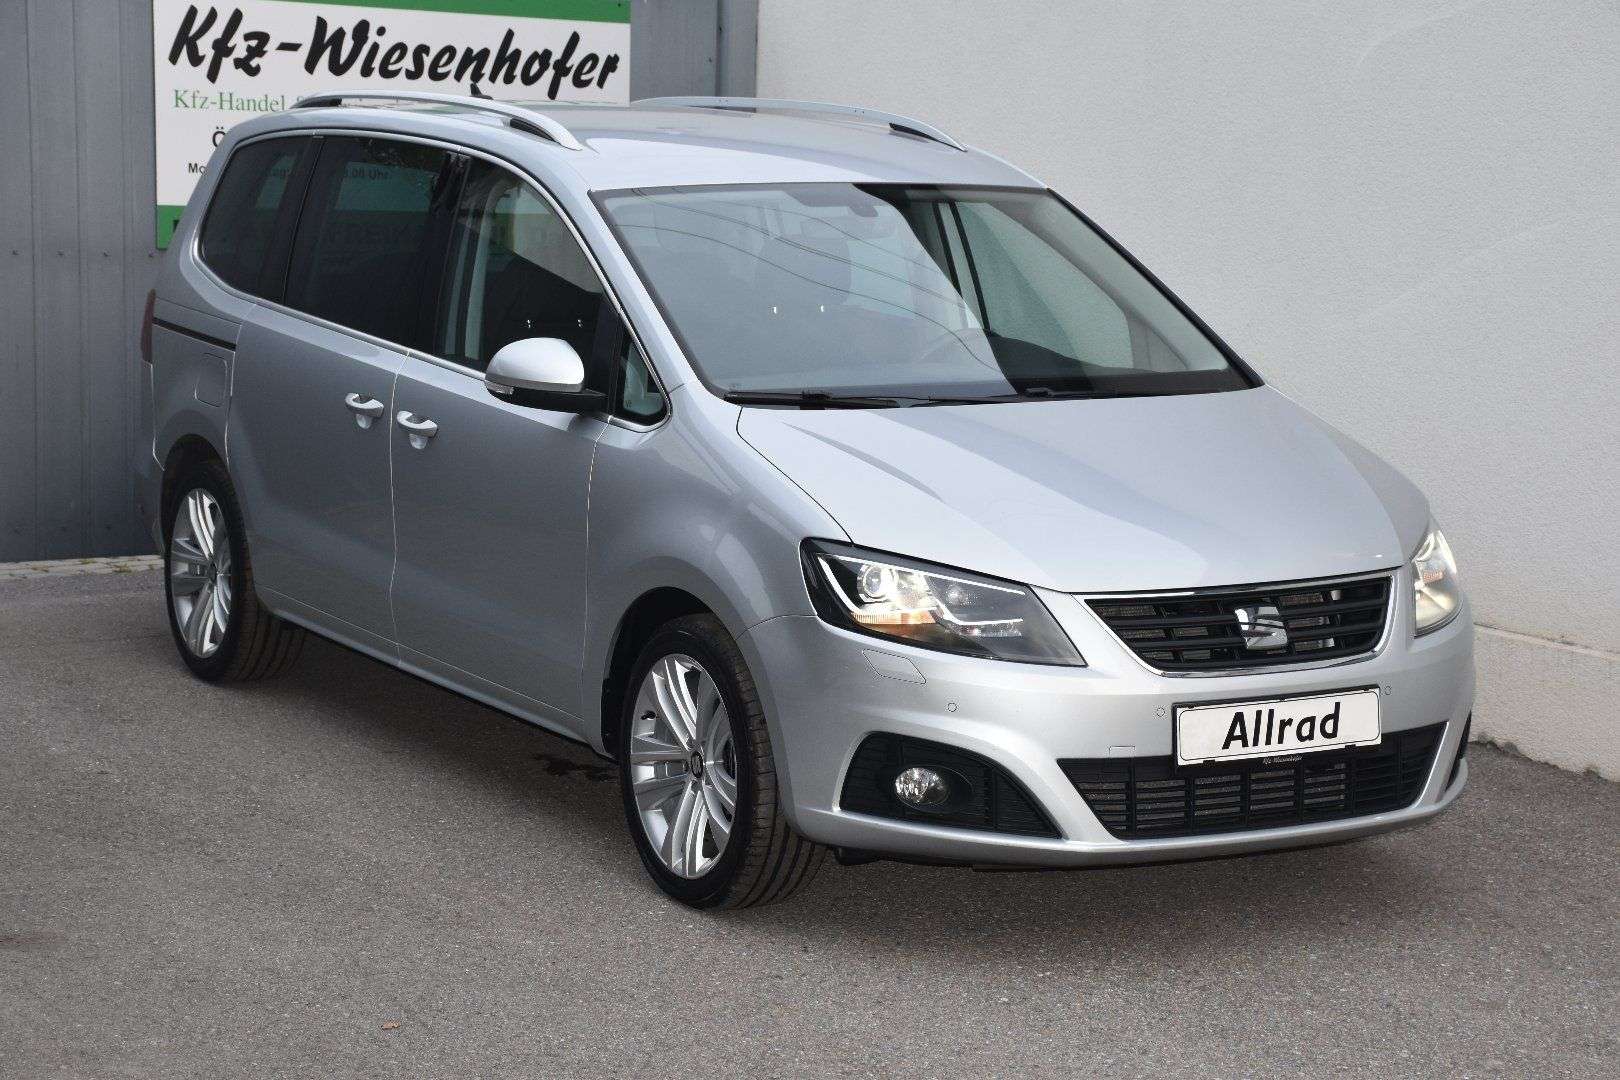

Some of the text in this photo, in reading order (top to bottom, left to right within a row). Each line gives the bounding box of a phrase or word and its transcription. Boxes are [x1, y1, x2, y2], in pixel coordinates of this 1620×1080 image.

[168, 5, 620, 101] Kfz-Wiesenhofer
[173, 89, 286, 112] Kfz-Handel
[1222, 701, 1341, 750] Allrad
